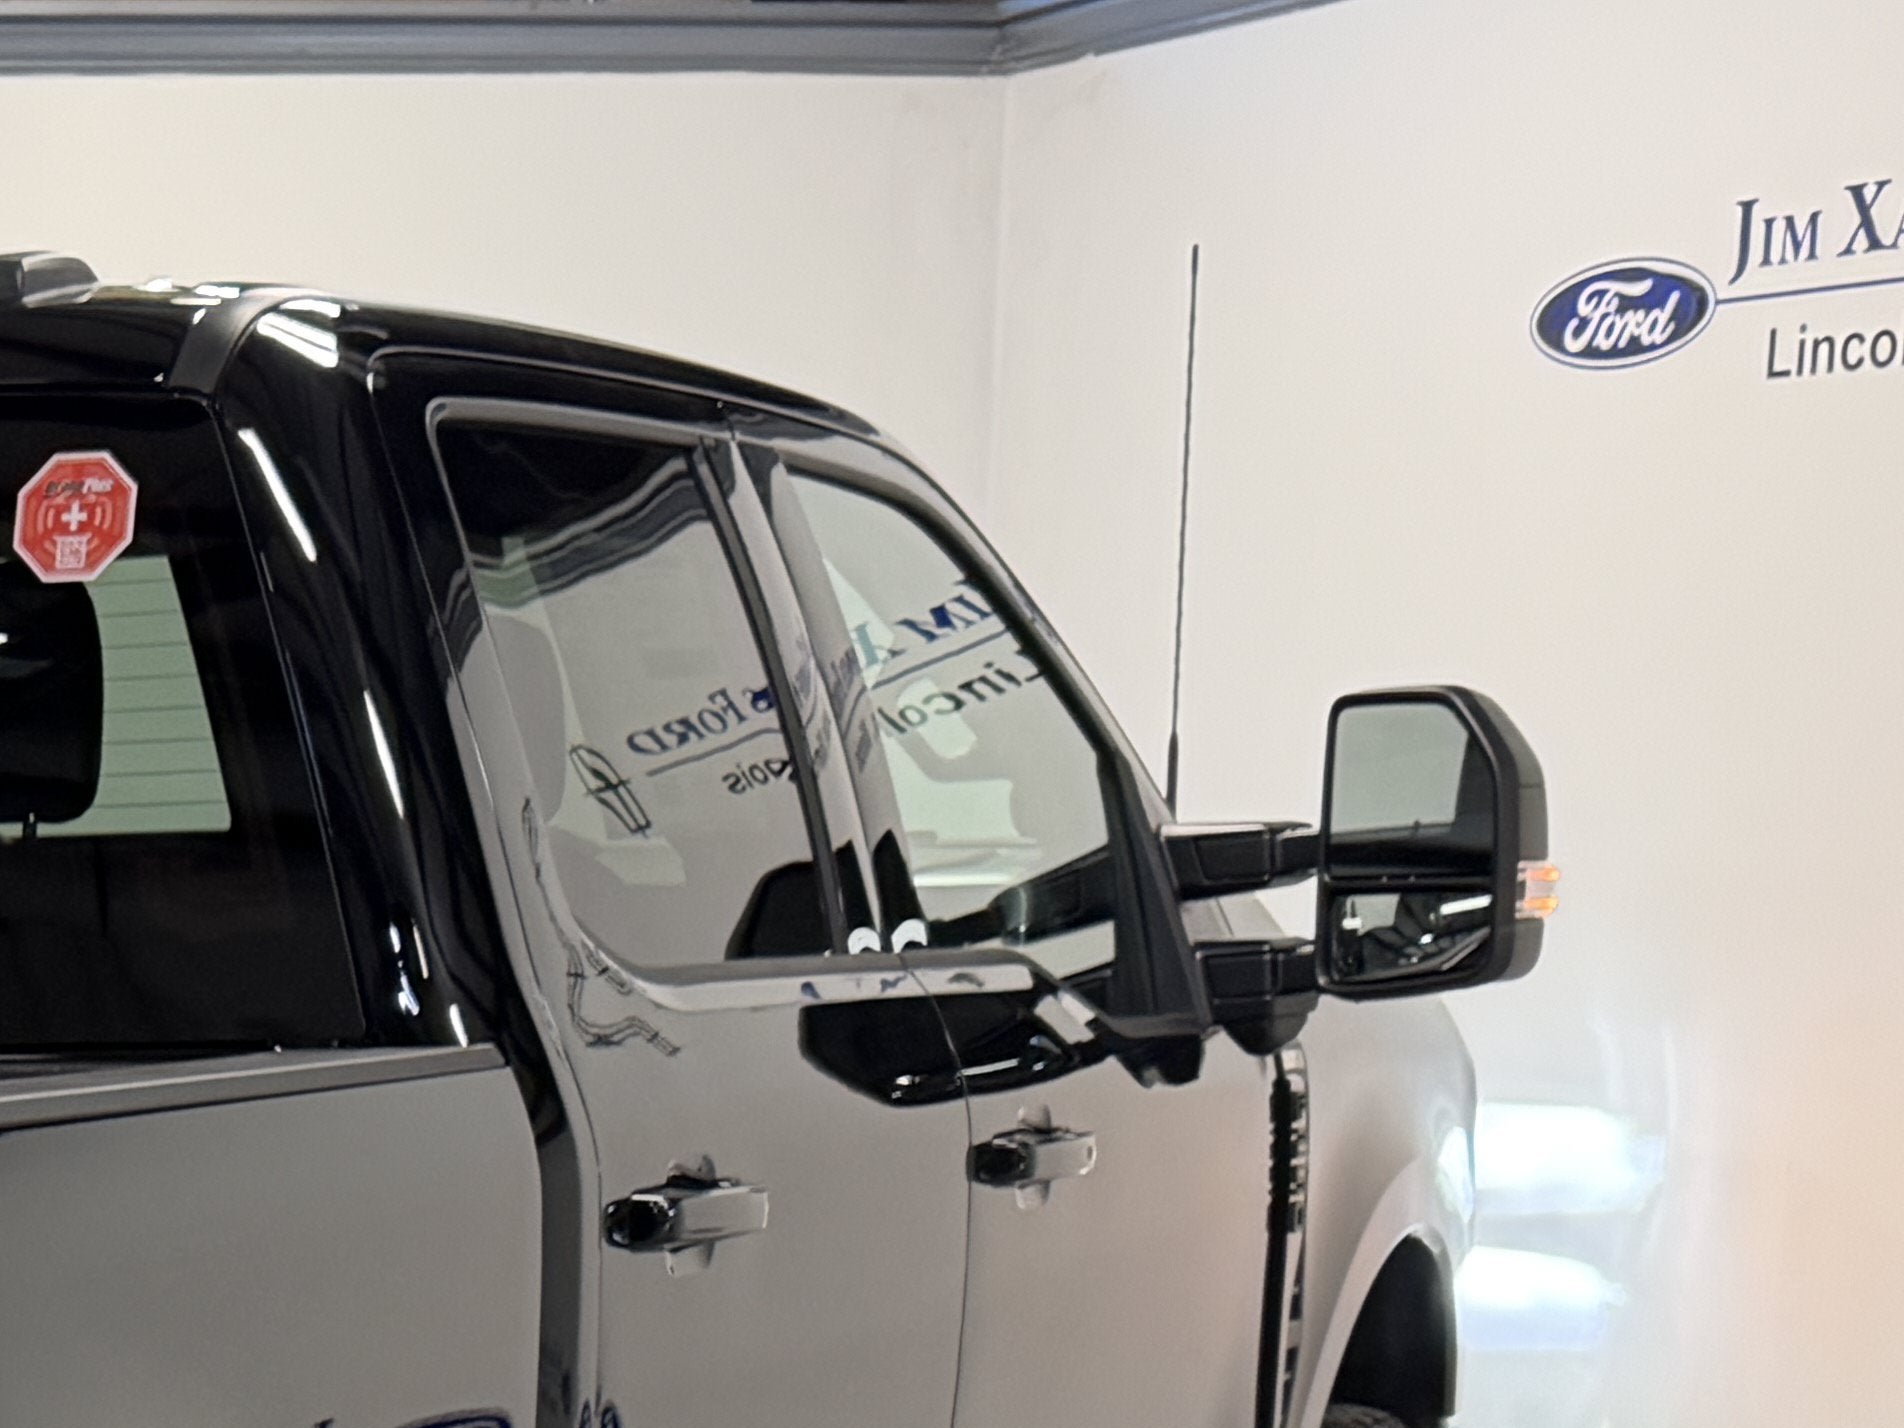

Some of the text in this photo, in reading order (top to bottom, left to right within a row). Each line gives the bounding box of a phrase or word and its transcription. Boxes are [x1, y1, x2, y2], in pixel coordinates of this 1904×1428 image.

[1728, 197, 1823, 287] JIM
[1563, 278, 1681, 354] Ford
[1767, 323, 1904, 379] Linco
